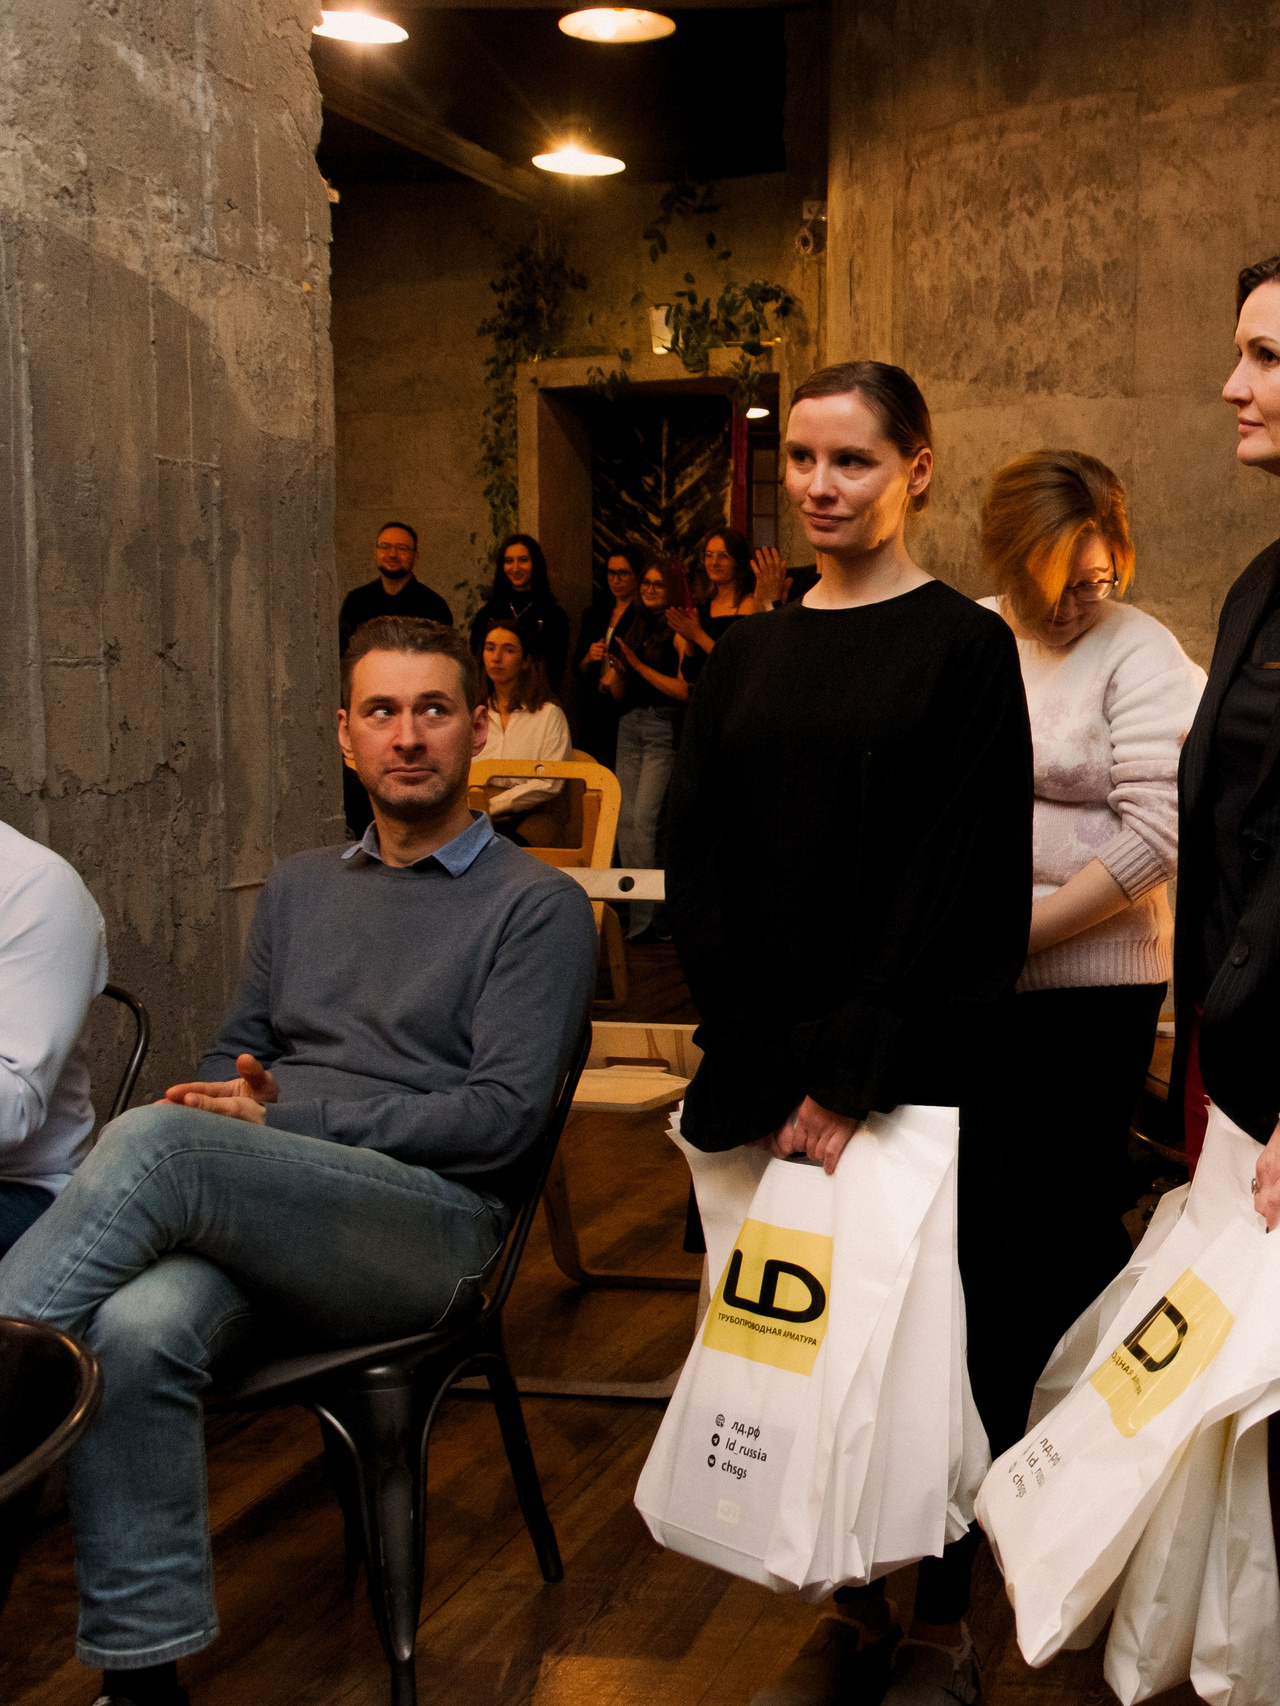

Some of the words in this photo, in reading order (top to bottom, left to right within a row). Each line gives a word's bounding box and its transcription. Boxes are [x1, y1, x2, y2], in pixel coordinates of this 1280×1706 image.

[722, 1248, 827, 1324] LD
[717, 1312, 783, 1336] ТРУБОПРОВОДНАЯ
[782, 1330, 817, 1346] АРМАТУРА
[731, 1421, 761, 1441] лд.рф
[725, 1437, 768, 1462] ld_russia
[721, 1459, 748, 1480] chsgs
[1025, 1451, 1046, 1489] ld_russ
